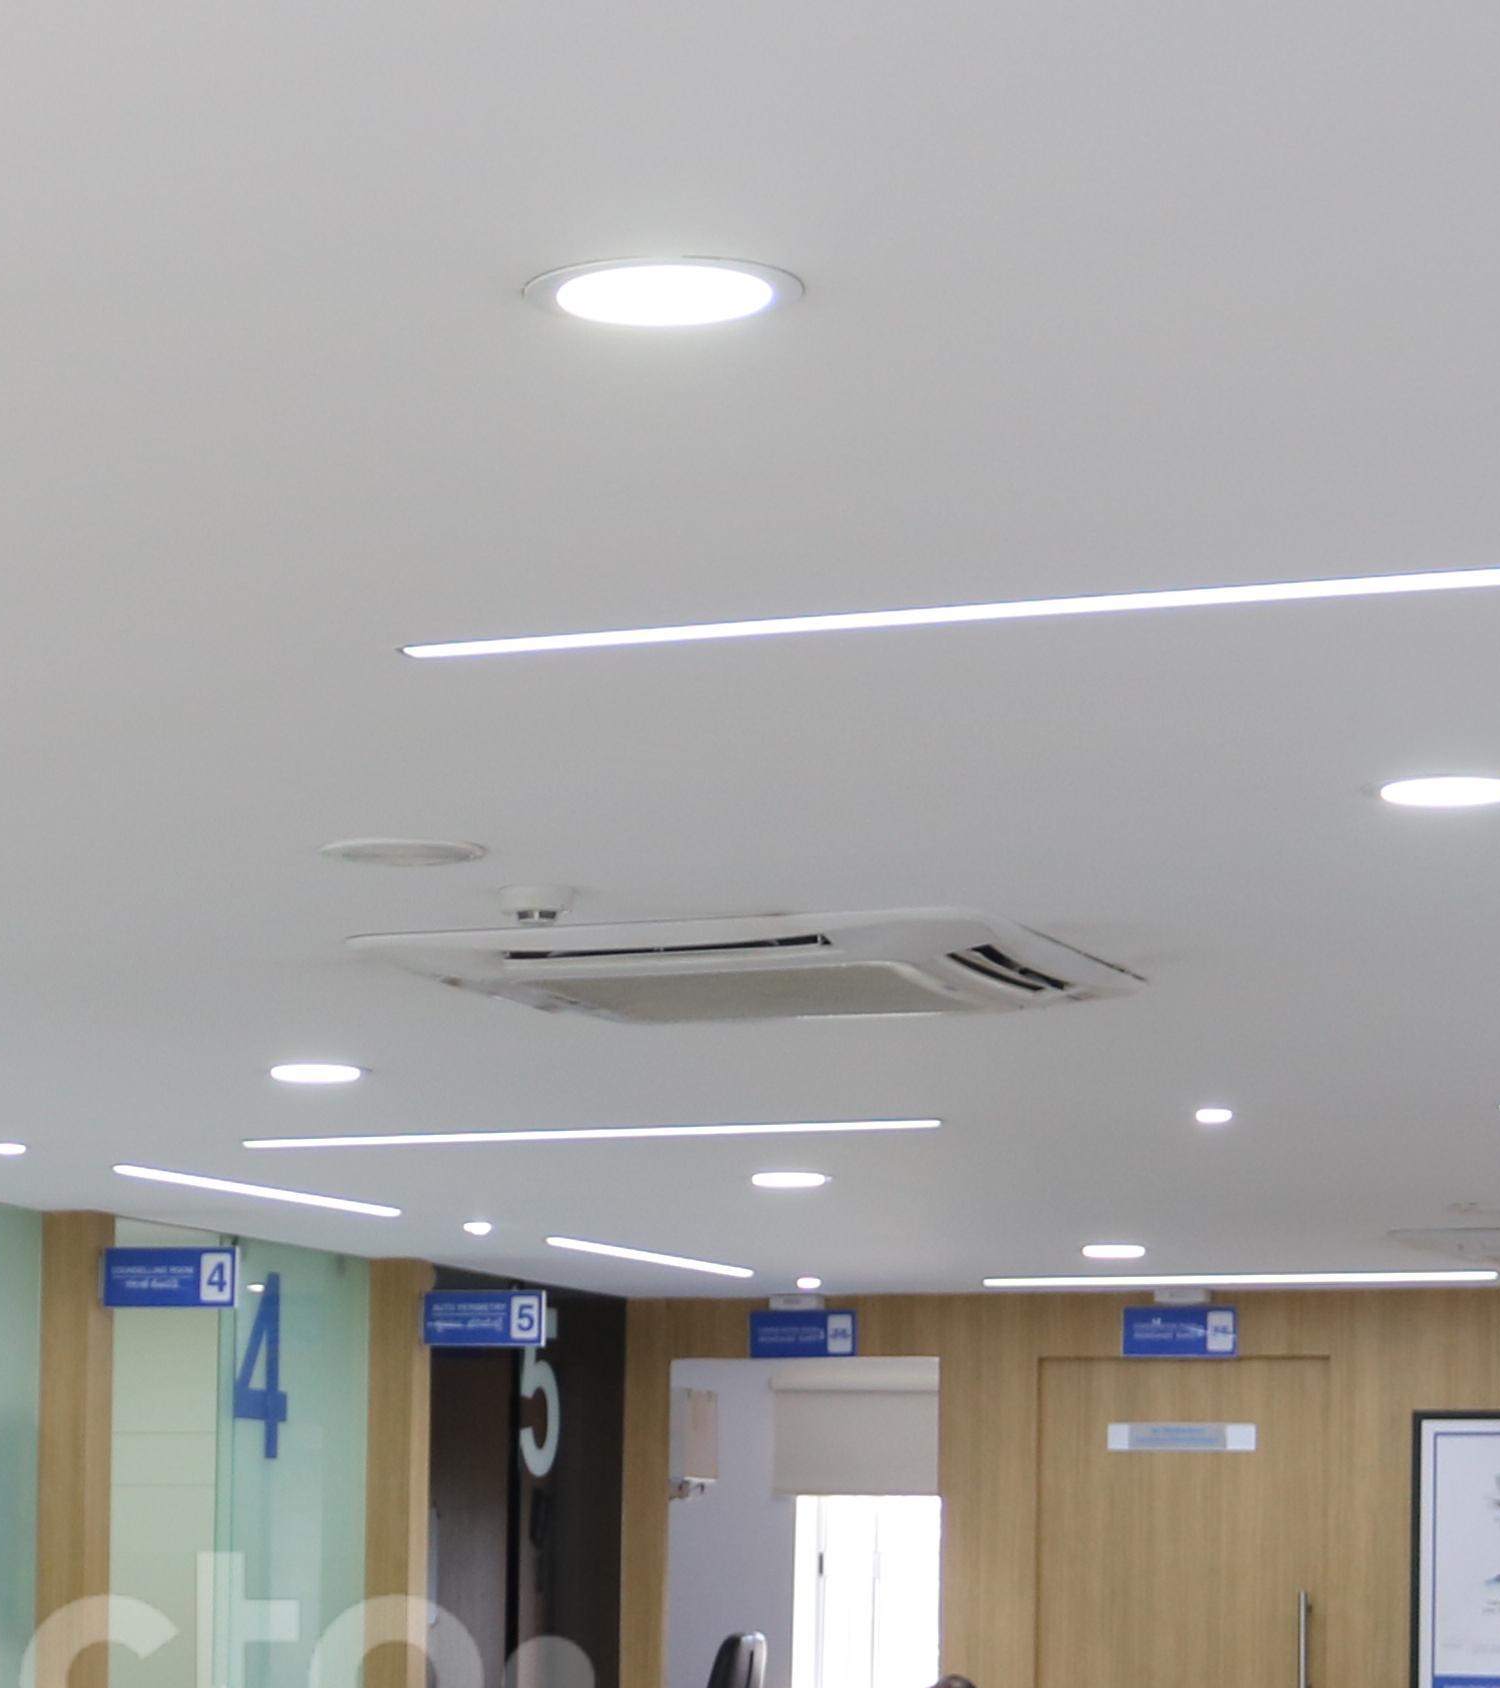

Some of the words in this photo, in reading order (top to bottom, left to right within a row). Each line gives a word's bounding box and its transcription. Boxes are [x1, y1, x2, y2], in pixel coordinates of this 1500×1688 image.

[206, 1261, 227, 1293] 4
[517, 1304, 534, 1332] 5
[234, 1273, 287, 1459] 4
[519, 1345, 560, 1477] 5
